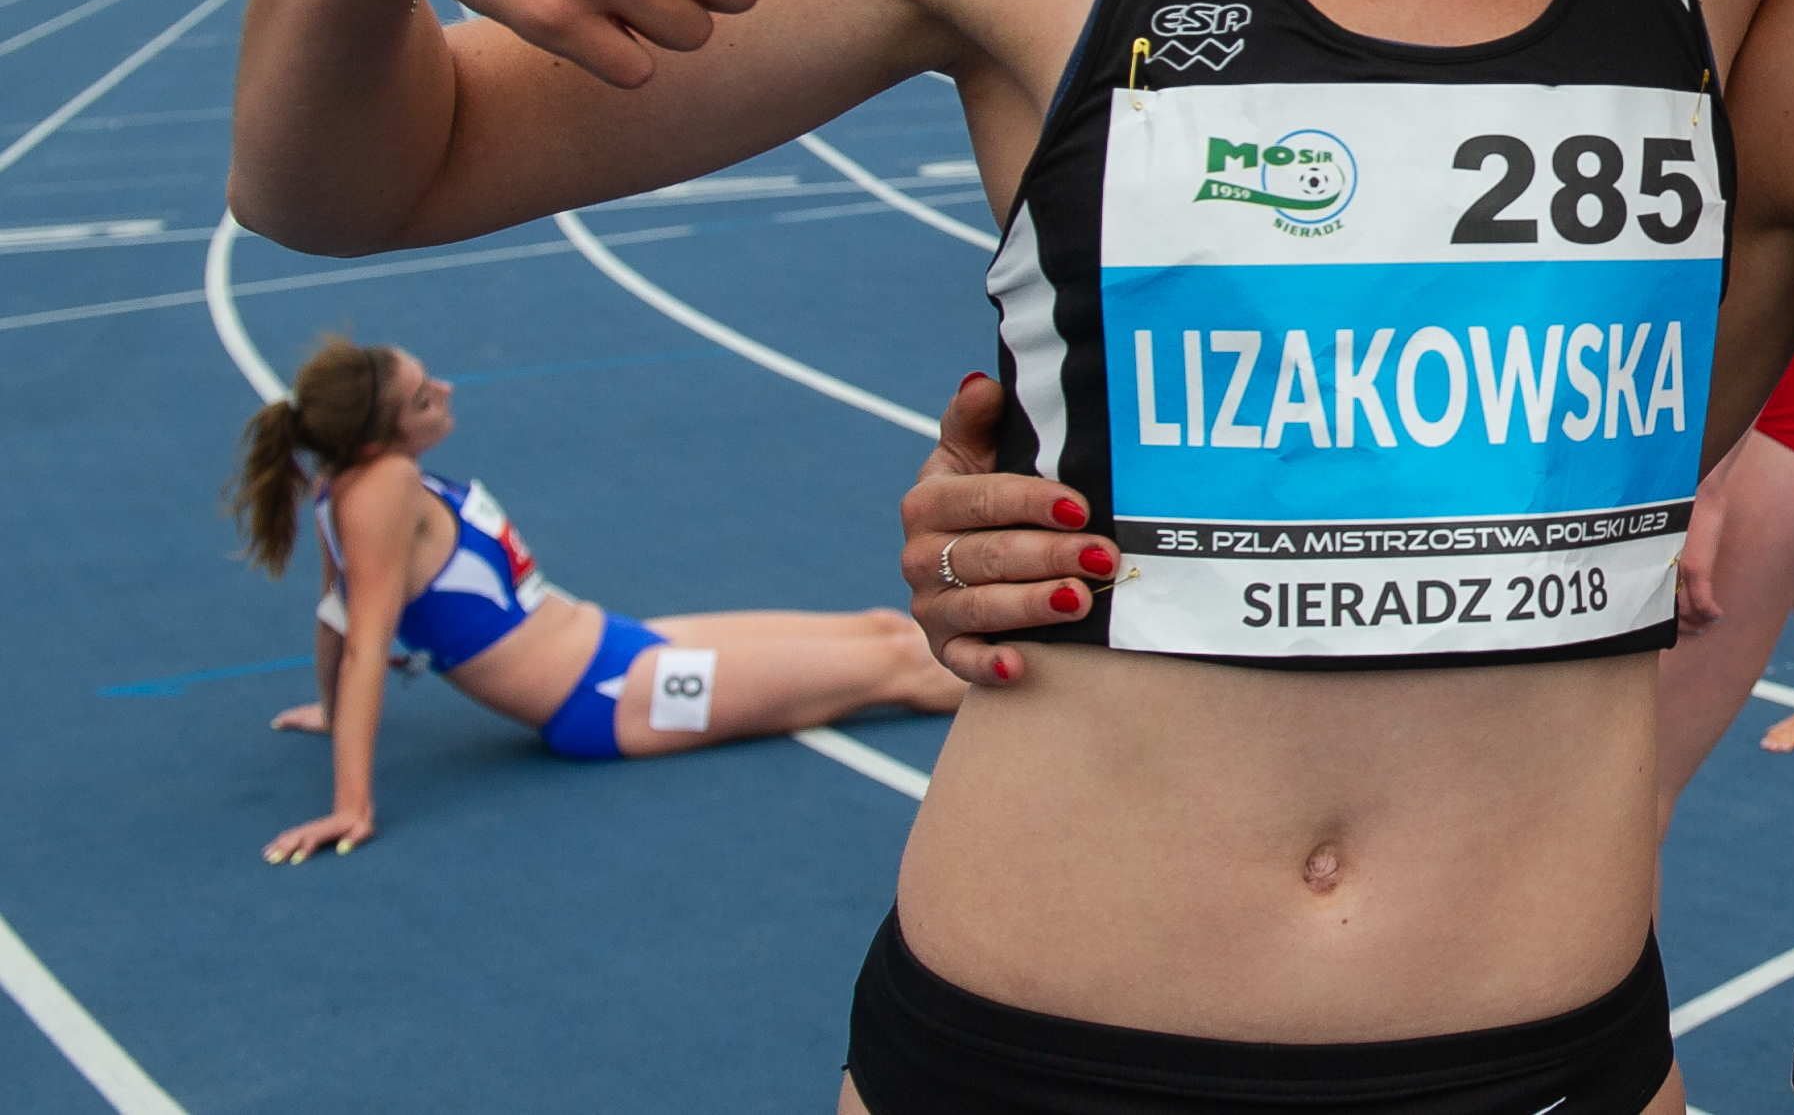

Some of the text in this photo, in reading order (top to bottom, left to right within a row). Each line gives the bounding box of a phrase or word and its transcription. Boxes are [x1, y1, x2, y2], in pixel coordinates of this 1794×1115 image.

[1209, 182, 1251, 200] 1959
[1449, 134, 1703, 246] 285
[1271, 217, 1345, 238] SIERADZ
[1133, 320, 1687, 449] LIZAKOWSKA
[1156, 511, 1669, 554] 35. PZLA MISTRZOSTWA POLSKI U23
[1241, 566, 1608, 628] SIERADZ 2018
